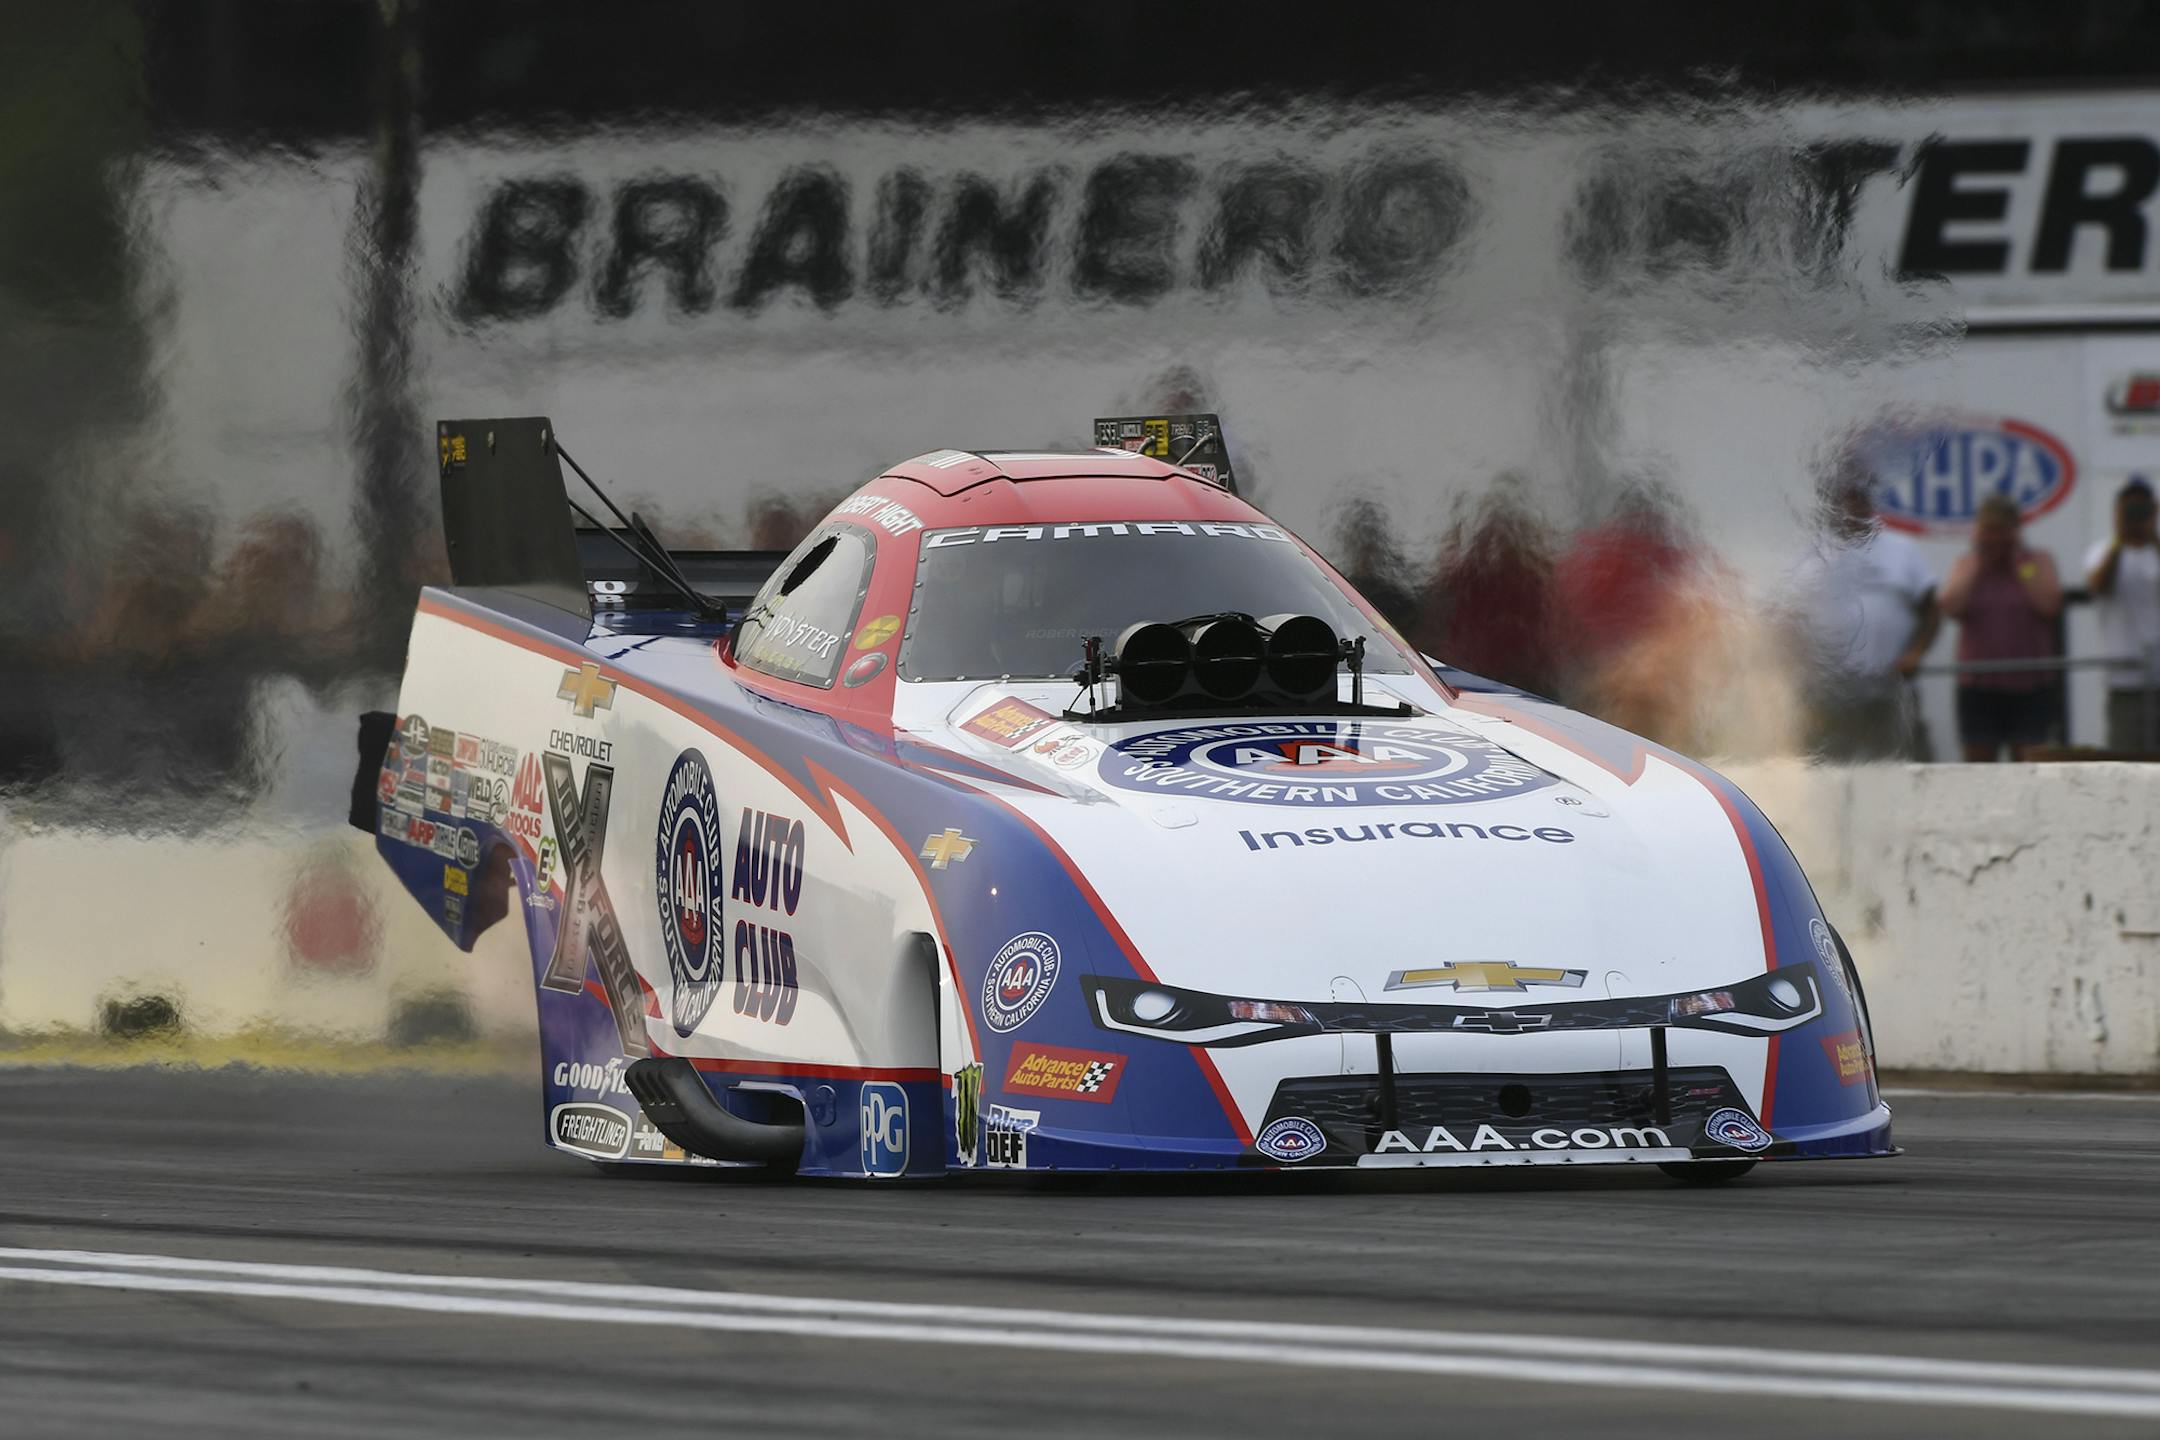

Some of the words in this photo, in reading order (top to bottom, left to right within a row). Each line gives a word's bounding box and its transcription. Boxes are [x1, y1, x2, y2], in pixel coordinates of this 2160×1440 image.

[926, 523, 1293, 549] CAMARO
[550, 729, 613, 763] CHEVROLET
[1118, 723, 1371, 757] AUTOMOBILE
[1235, 744, 1431, 765] AAA
[512, 752, 543, 815] MAC
[1123, 761, 1358, 802] SOUTHERN
[510, 811, 541, 839] TOOLS
[660, 761, 708, 858] AUTOMOBILE
[703, 793, 720, 872] CLUB
[1238, 821, 1576, 851] Insurance
[731, 806, 805, 917] AUTO
[676, 852, 706, 923] AAA
[588, 887, 639, 1032] FORCE
[685, 895, 722, 1026] CALIFORNIA
[993, 937, 1047, 972] AUTOMOBILE
[1041, 946, 1056, 972] CLUB
[732, 918, 799, 1027] CLUB
[1001, 966, 1034, 990] AAA
[985, 978, 1005, 1027] SOUTHERN
[1003, 978, 1052, 1027] CALIFORNIA
[554, 1058, 633, 1099] GOODYE
[1010, 1070, 1039, 1087] Auto
[1039, 1073, 1076, 1091] Parts
[1020, 1053, 1084, 1077] Advance
[560, 1114, 627, 1148] FREIGHTLINER
[863, 1092, 903, 1165] PPG
[1262, 1121, 1306, 1143] AUTOMOBILE
[1304, 1125, 1321, 1144] CLUB
[1373, 1124, 1673, 1153] AAA.com
[1709, 1112, 1741, 1136] AUTOMOBILE
[1740, 1116, 1757, 1133] CLUB
[987, 1131, 1024, 1164] DEF
[1276, 1139, 1306, 1148] AAA
